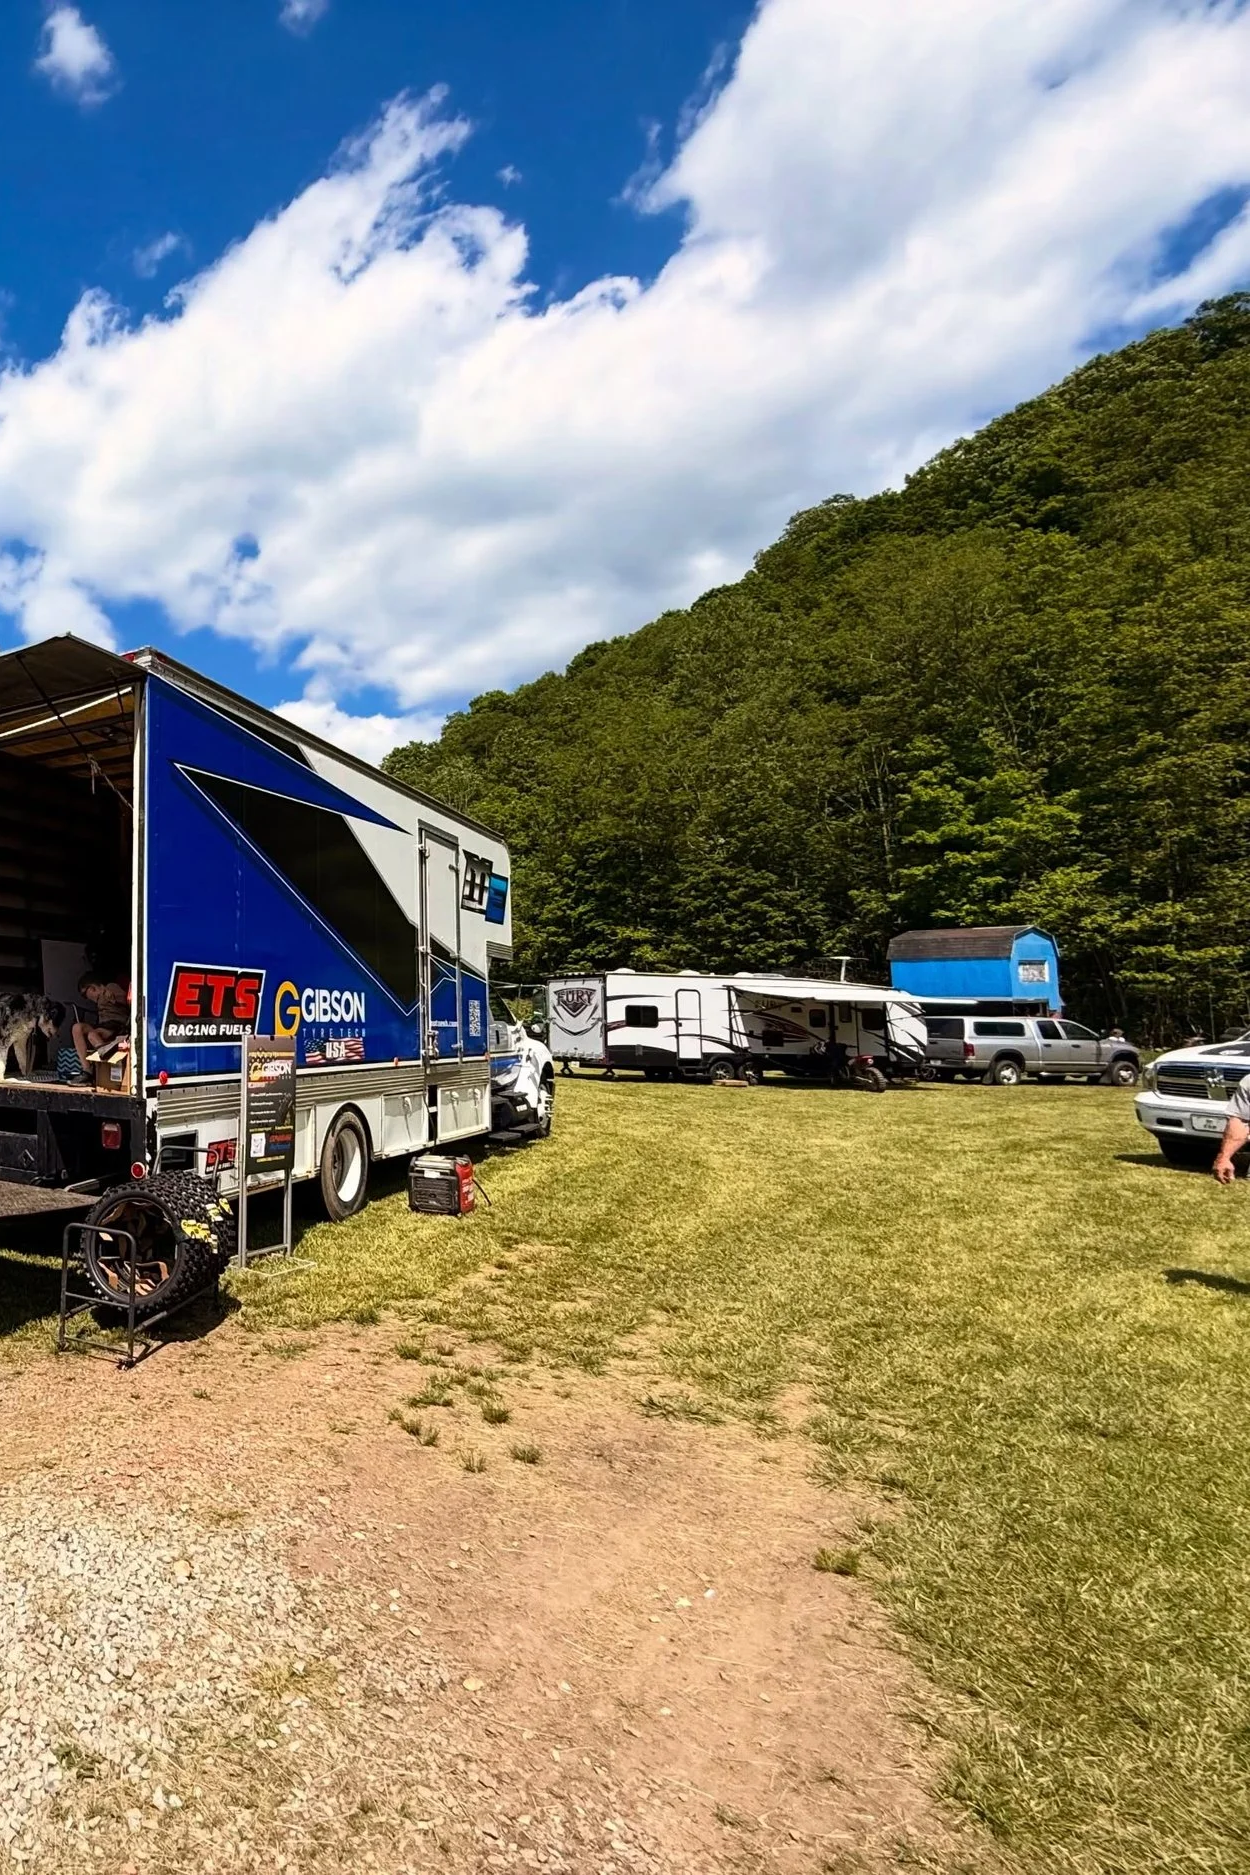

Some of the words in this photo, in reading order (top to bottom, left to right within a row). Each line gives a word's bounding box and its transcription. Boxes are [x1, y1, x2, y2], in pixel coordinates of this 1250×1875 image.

[173, 972, 259, 1019] ETS
[556, 989, 593, 1006] FURY
[301, 987, 366, 1023] GIBSON
[219, 1024, 252, 1036] FUELS
[302, 1028, 334, 1038] TYRE
[339, 1028, 367, 1038] TECH
[325, 1041, 346, 1058] USA
